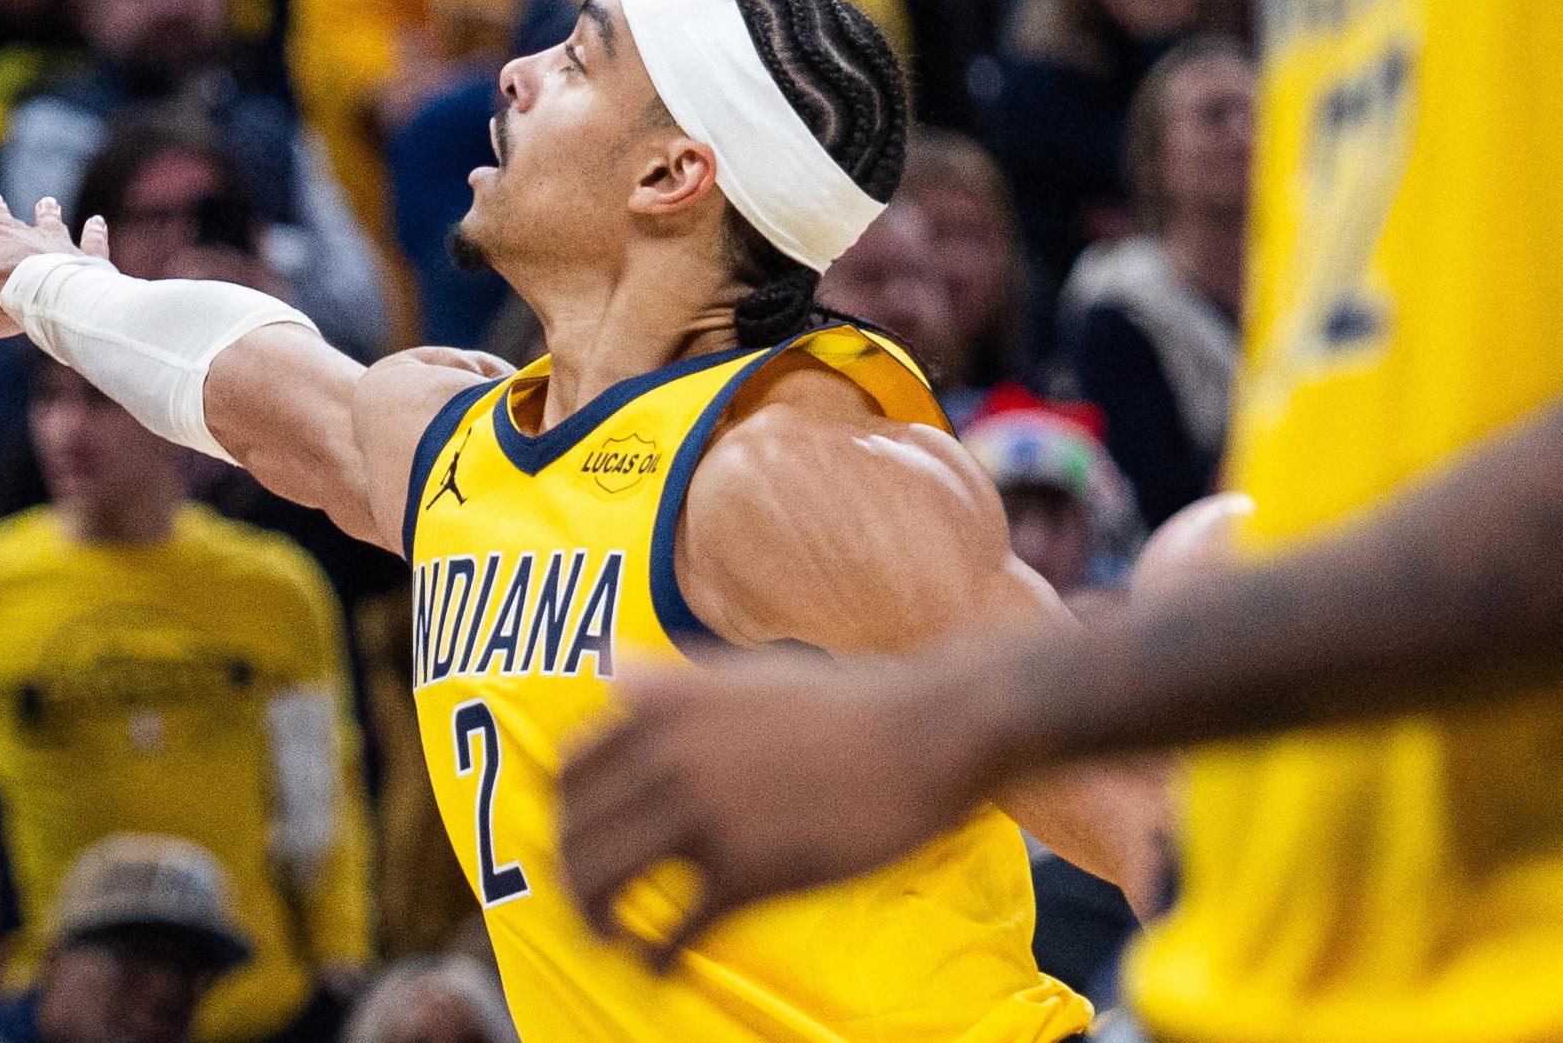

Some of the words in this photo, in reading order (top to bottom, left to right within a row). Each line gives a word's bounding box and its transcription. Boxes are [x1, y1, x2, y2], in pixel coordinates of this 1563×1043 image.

[580, 451, 639, 474] LUCAS
[413, 548, 624, 693] NDIANA
[451, 696, 532, 910] 2
